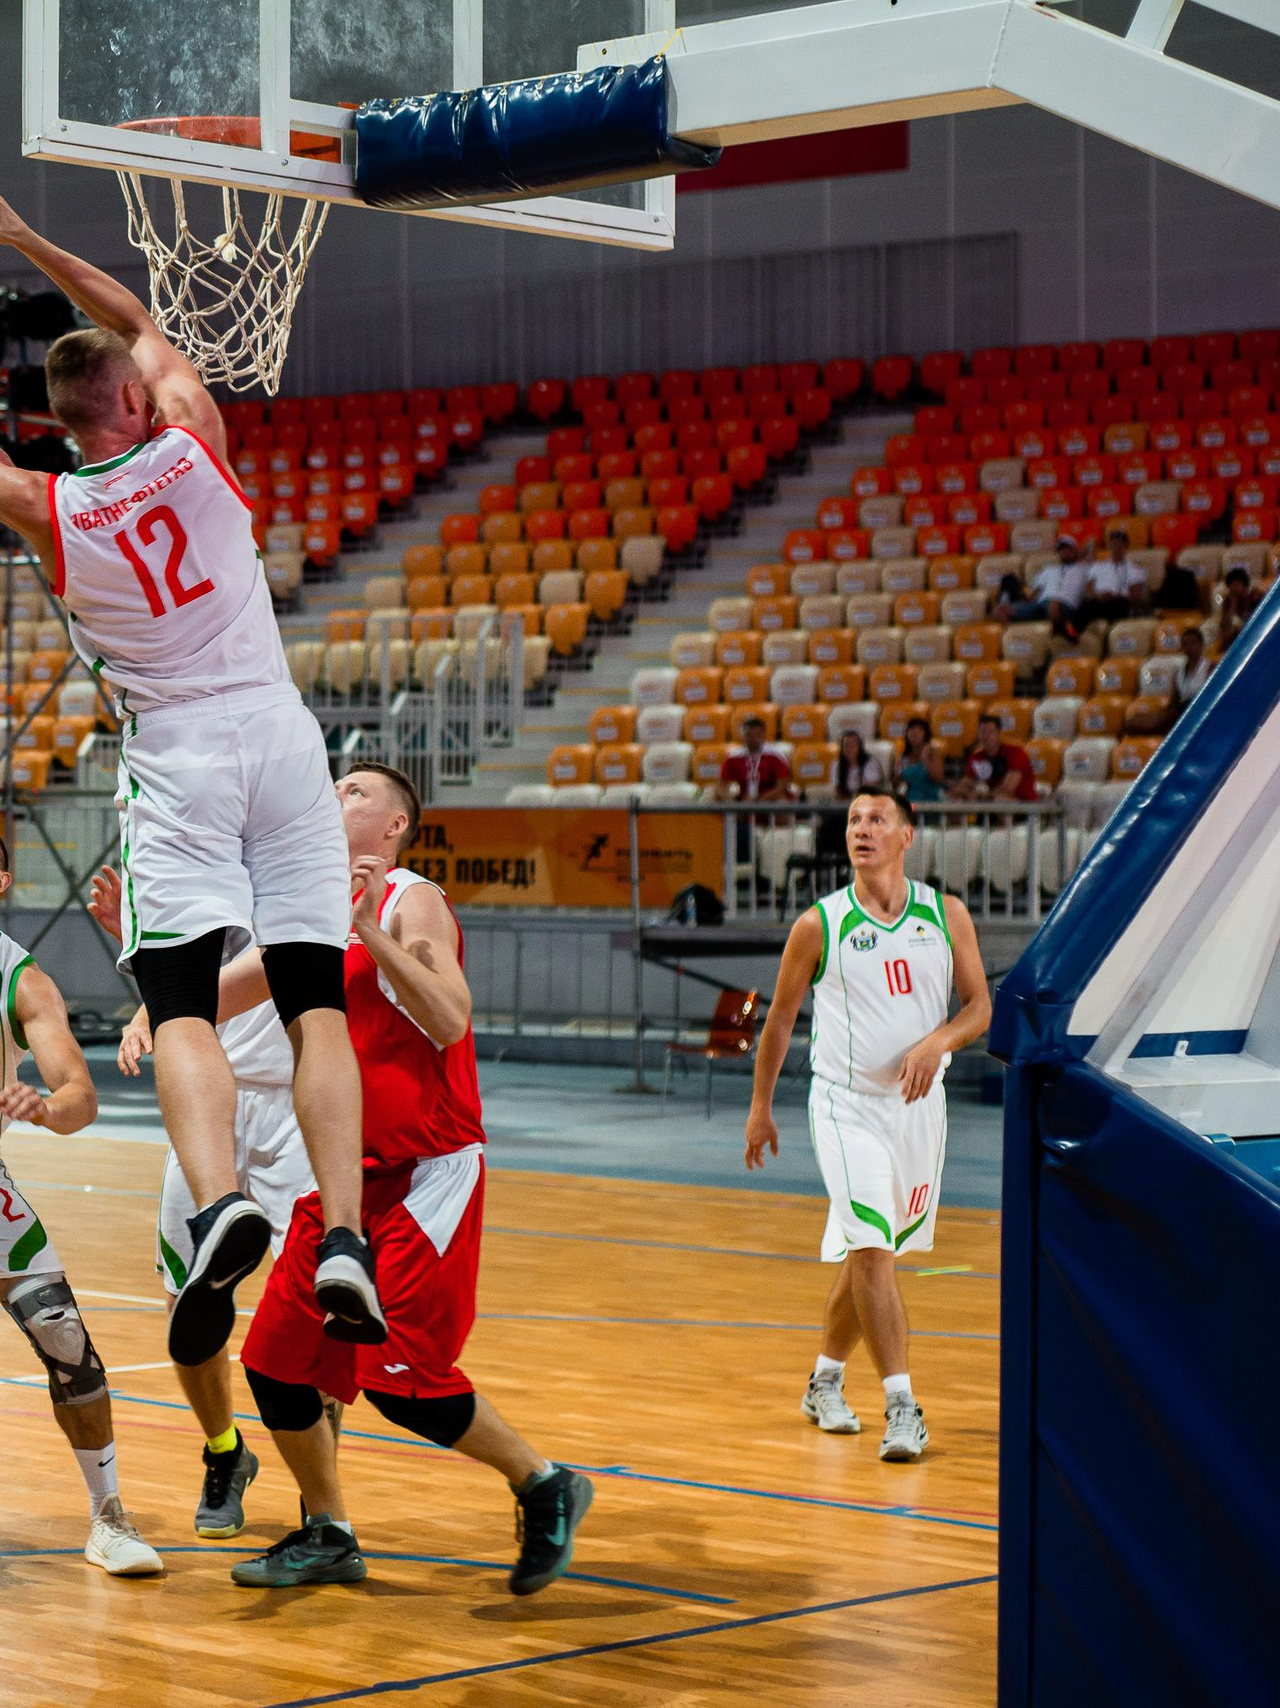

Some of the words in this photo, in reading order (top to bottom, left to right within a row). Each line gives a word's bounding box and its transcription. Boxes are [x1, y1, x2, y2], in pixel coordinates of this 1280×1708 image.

[113, 504, 216, 618] 12
[456, 857, 536, 889] ПОБЕД!
[884, 958, 913, 997] 10
[907, 1183, 929, 1219] 10
